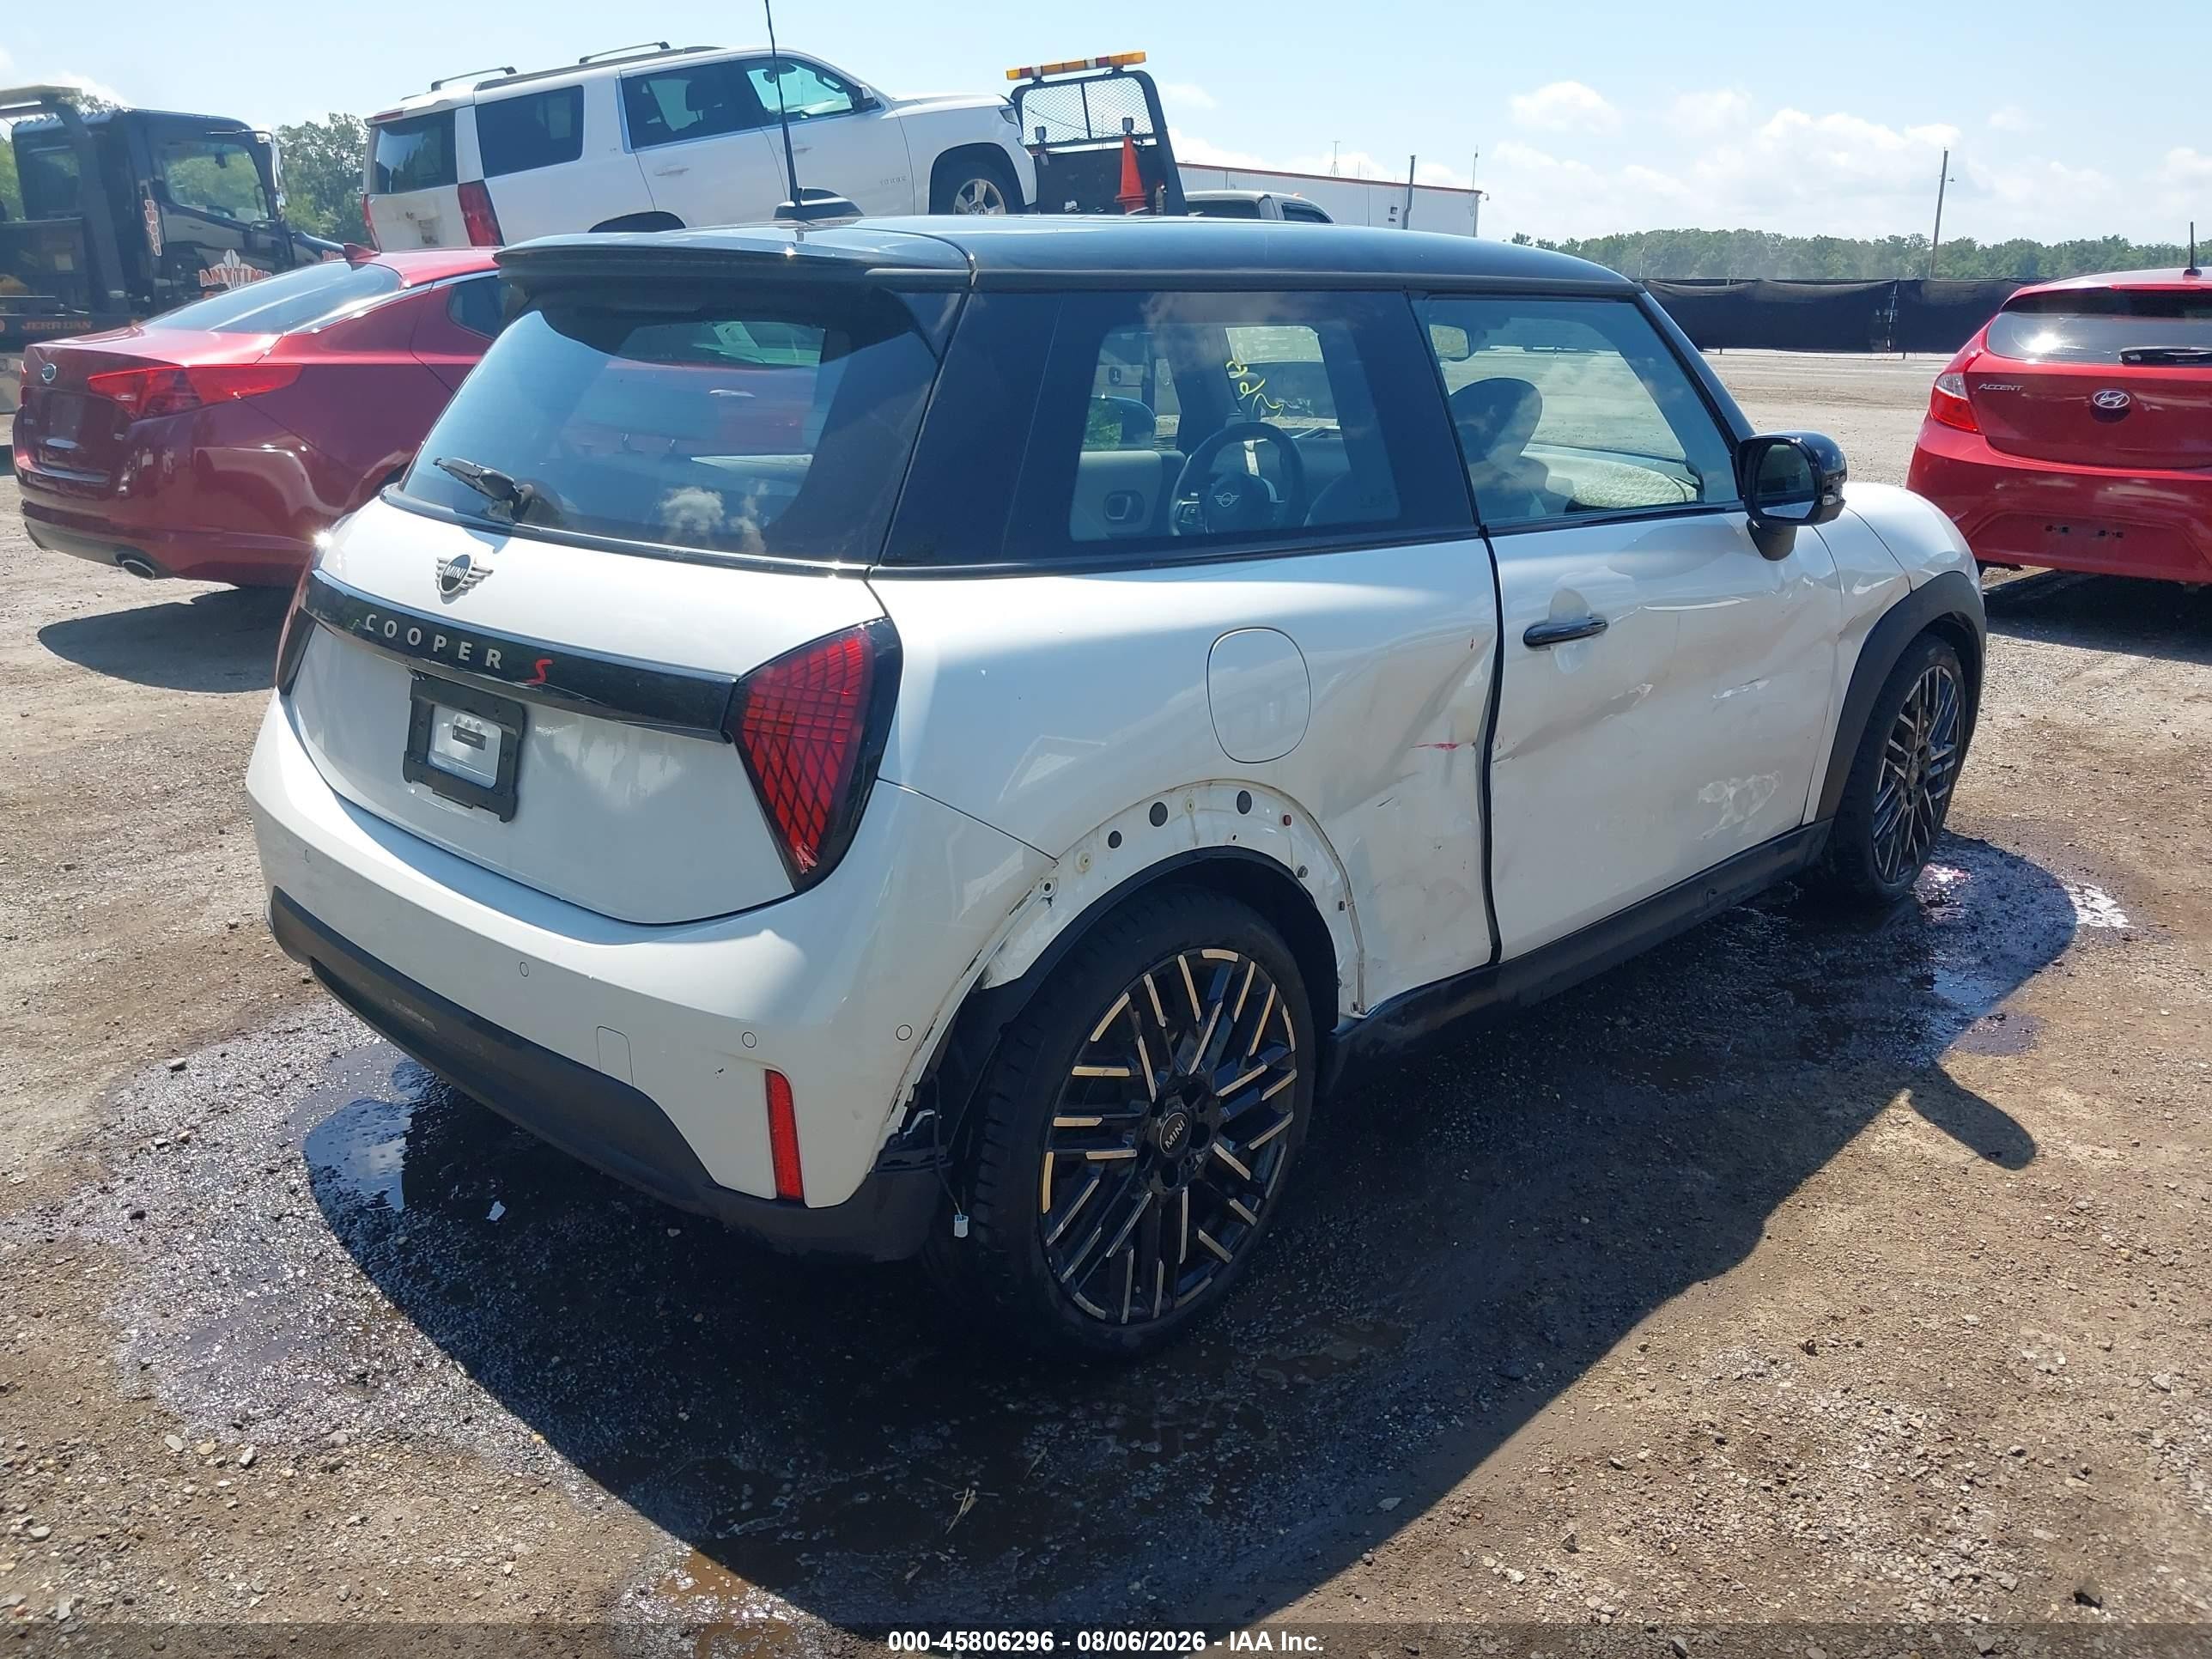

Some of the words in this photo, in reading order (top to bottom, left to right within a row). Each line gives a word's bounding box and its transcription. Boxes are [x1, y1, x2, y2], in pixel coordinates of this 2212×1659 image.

[1978, 383, 2025, 392] ACCENT
[444, 564, 467, 580] MINI
[365, 613, 502, 670] COOPER
[523, 659, 553, 685] S
[1164, 1119, 1186, 1149] MINI
